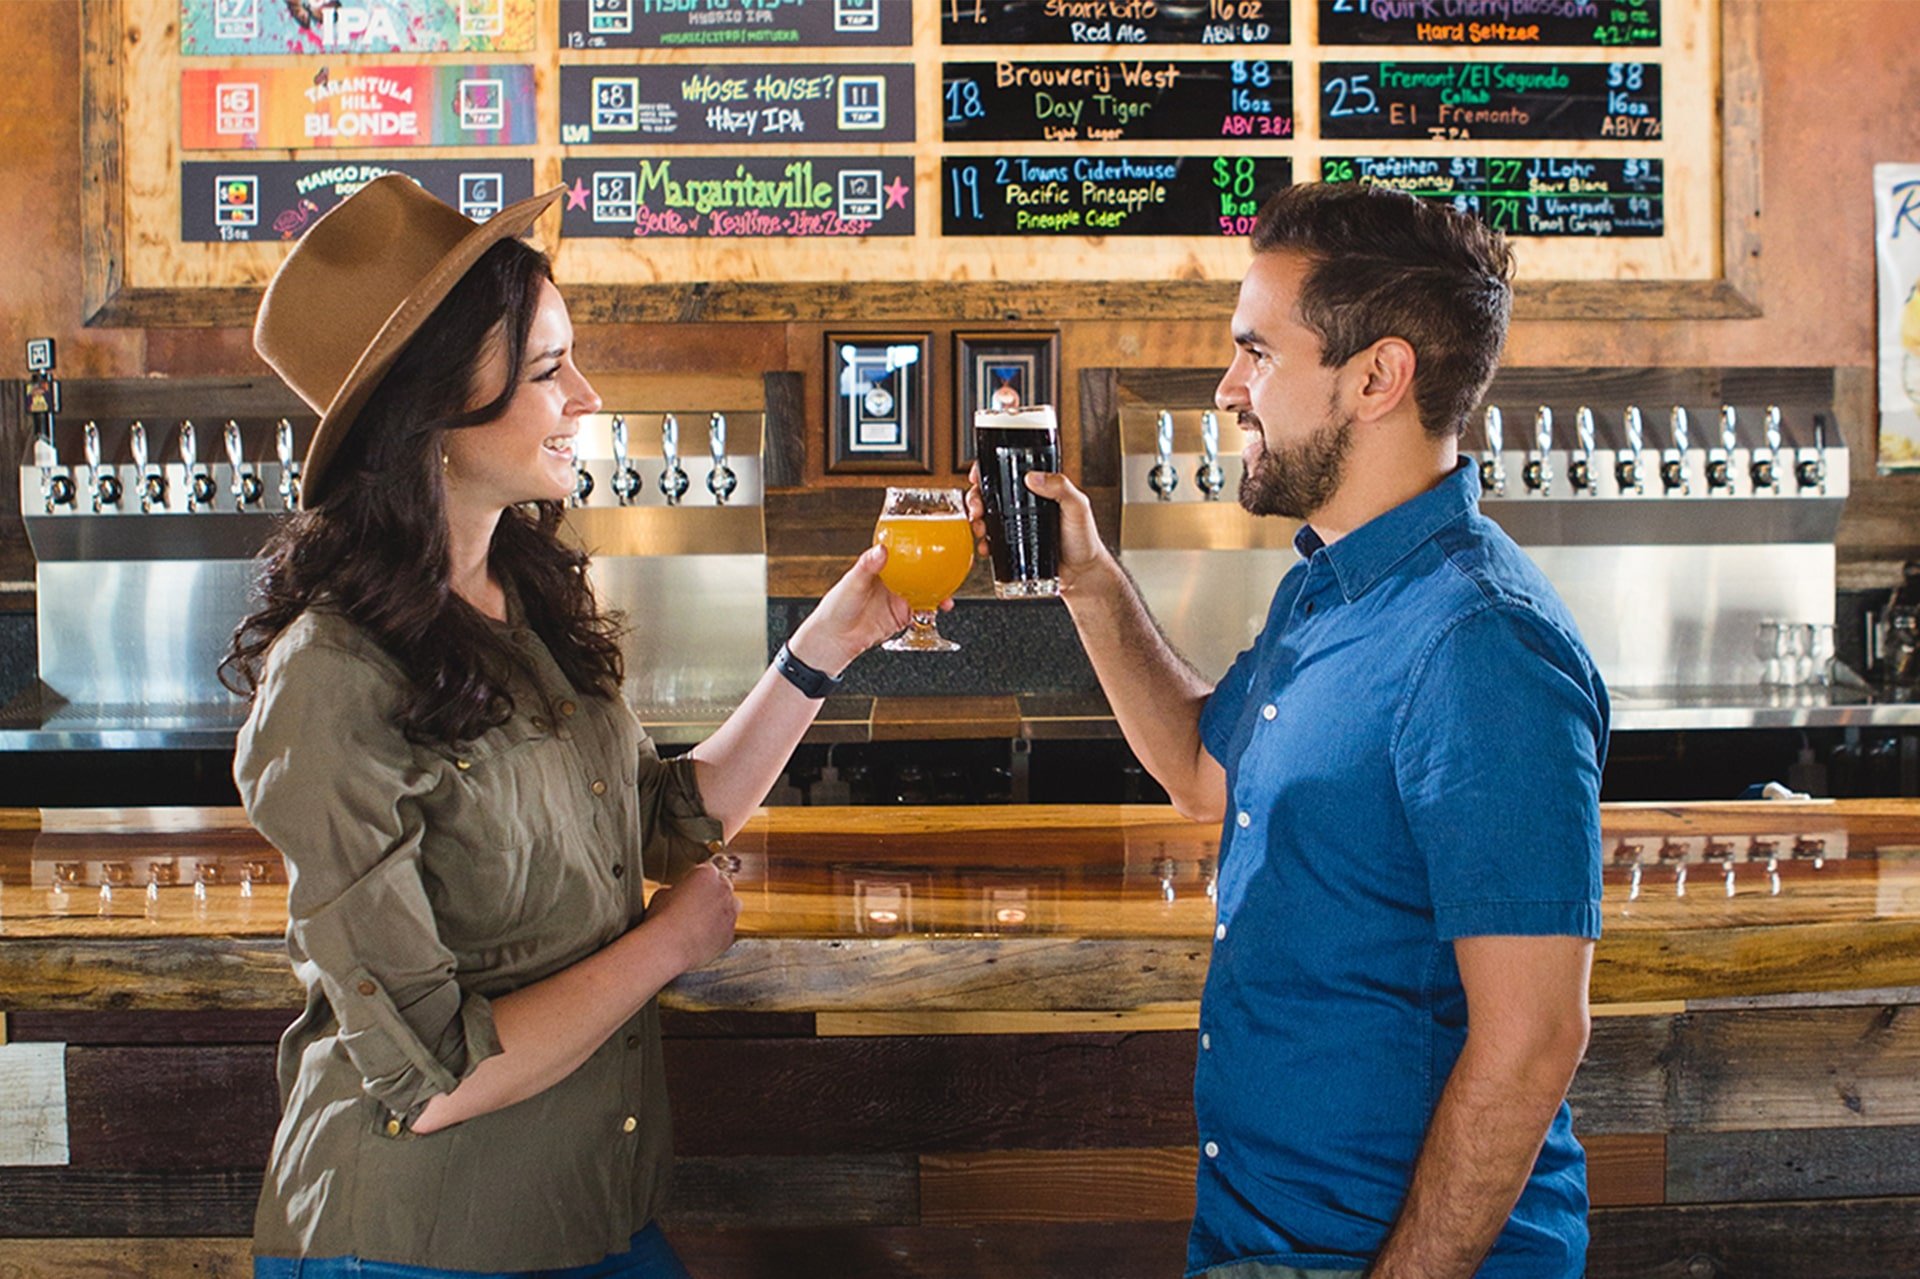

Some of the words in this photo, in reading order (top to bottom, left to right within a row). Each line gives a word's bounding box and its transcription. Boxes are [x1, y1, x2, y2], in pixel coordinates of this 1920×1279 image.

[322, 7, 399, 45] IPA
[1071, 22, 1111, 43] Red
[1116, 24, 1148, 43] Ale
[1416, 22, 1464, 42] Hard
[568, 31, 584, 48] 13
[996, 61, 1110, 93] Brouwerij
[1120, 61, 1180, 89] West
[1230, 60, 1271, 88] $8
[1493, 64, 1570, 94] Segundo
[304, 76, 412, 104] TARANTULA
[600, 84, 626, 108] $8
[682, 73, 749, 104] WHOSE
[754, 73, 835, 102] HOUSE?
[945, 80, 986, 121] 18.
[1324, 74, 1380, 117] 25.
[341, 93, 383, 111] HILL
[1035, 91, 1083, 126] Day
[1092, 94, 1152, 124] Tiger
[1389, 102, 1417, 125] El
[1438, 103, 1530, 125] Fremonto
[304, 111, 418, 137] BLONDE
[761, 106, 805, 134] IPA
[851, 112, 873, 122] TAP
[1221, 114, 1253, 136] ABV
[1601, 116, 1640, 137] ABV
[296, 165, 359, 195] MANGO
[995, 159, 1011, 184] 2
[1015, 159, 1069, 182] Towns
[1073, 158, 1176, 182] Ciderhouse
[1212, 157, 1255, 197] $8
[1324, 161, 1353, 183] 26
[1355, 157, 1438, 177] Trefethen
[1490, 160, 1522, 184] 27
[1548, 158, 1595, 178] Lohr
[471, 180, 487, 202] 6
[600, 178, 625, 202] $8
[636, 160, 833, 214] Margaritaville
[952, 166, 984, 219] 19.
[1006, 182, 1070, 205] Pacific
[1082, 180, 1166, 213] Pineapple
[850, 204, 873, 215] TAP
[1016, 210, 1080, 230] Pineapple
[1085, 209, 1127, 227] Cider
